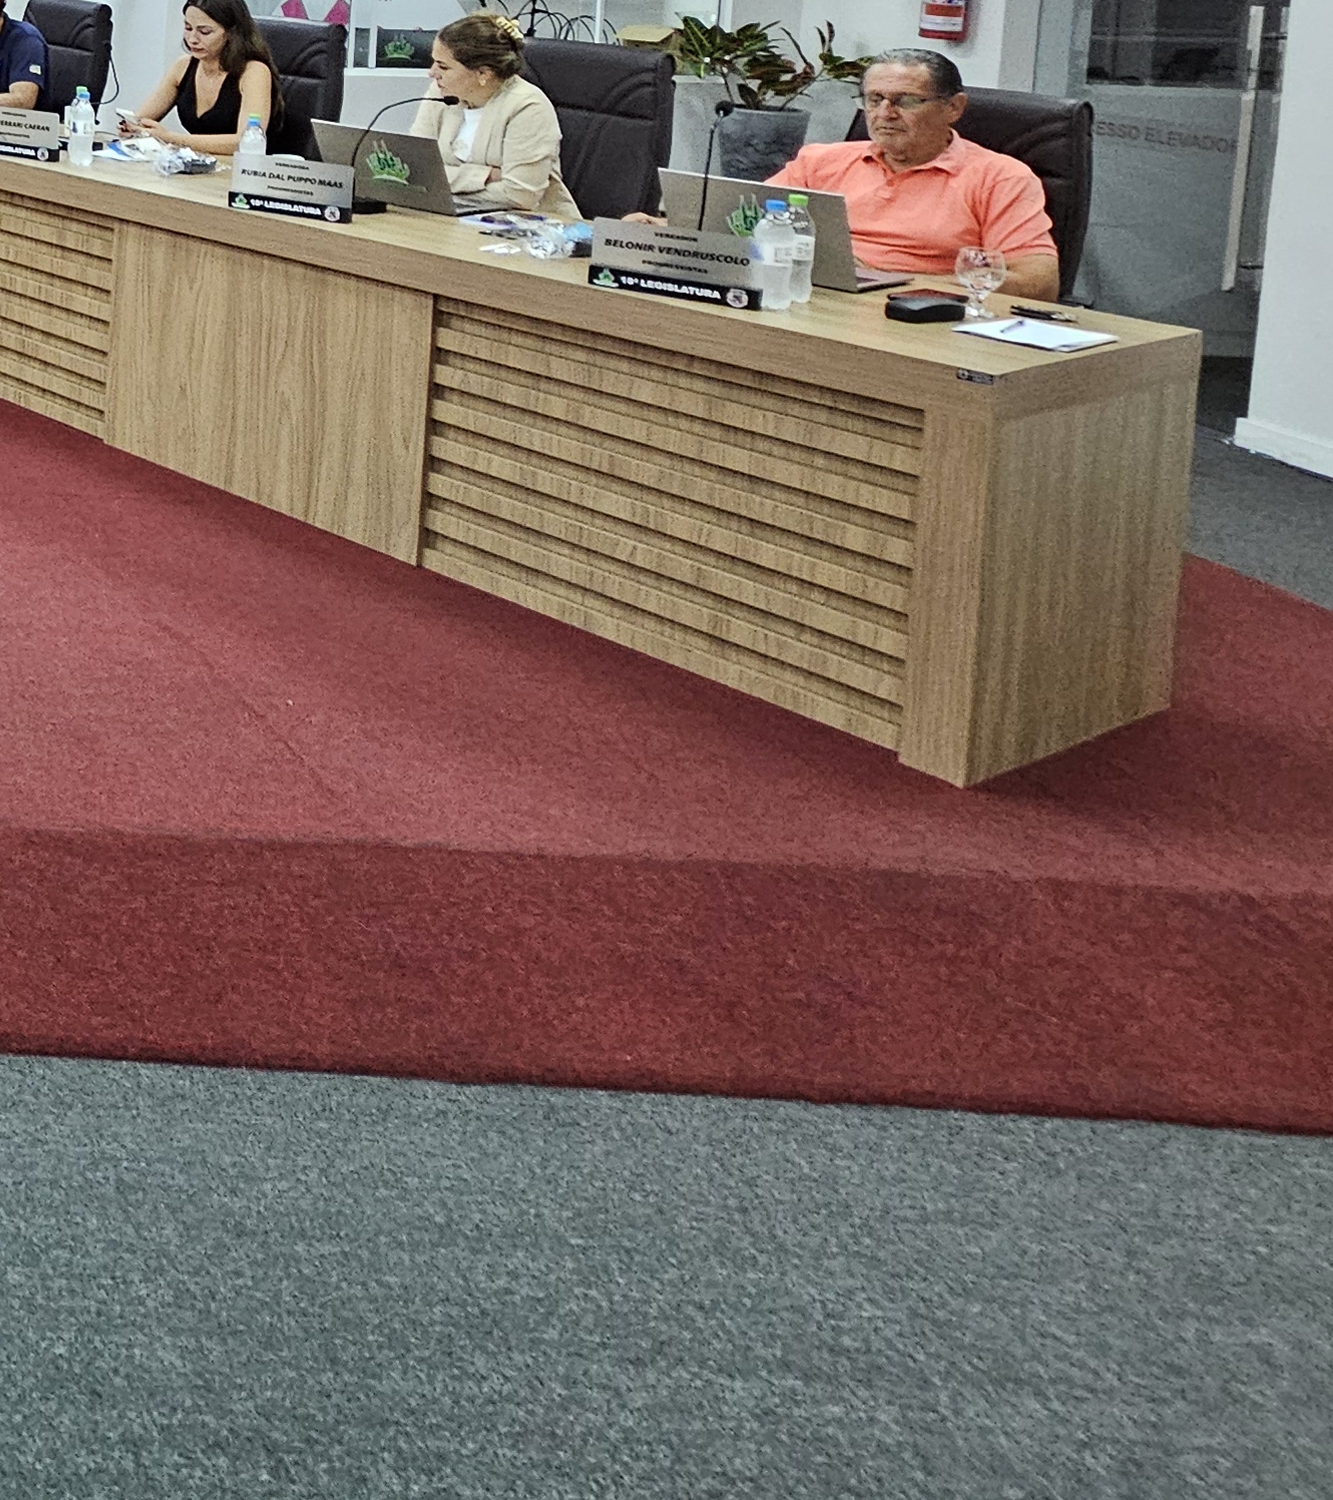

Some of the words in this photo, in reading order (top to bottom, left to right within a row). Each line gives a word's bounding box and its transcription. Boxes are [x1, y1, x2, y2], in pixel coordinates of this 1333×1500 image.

[241, 169, 267, 178] RUBIA
[268, 172, 285, 181] DAL
[287, 175, 317, 185] PUPPO
[317, 179, 343, 189] MAAS
[264, 200, 322, 216] LEGISLATURA
[604, 238, 656, 253] BELONIR
[657, 246, 751, 267] VENDRUSCOLO
[640, 278, 722, 300] LEGISLATURA
